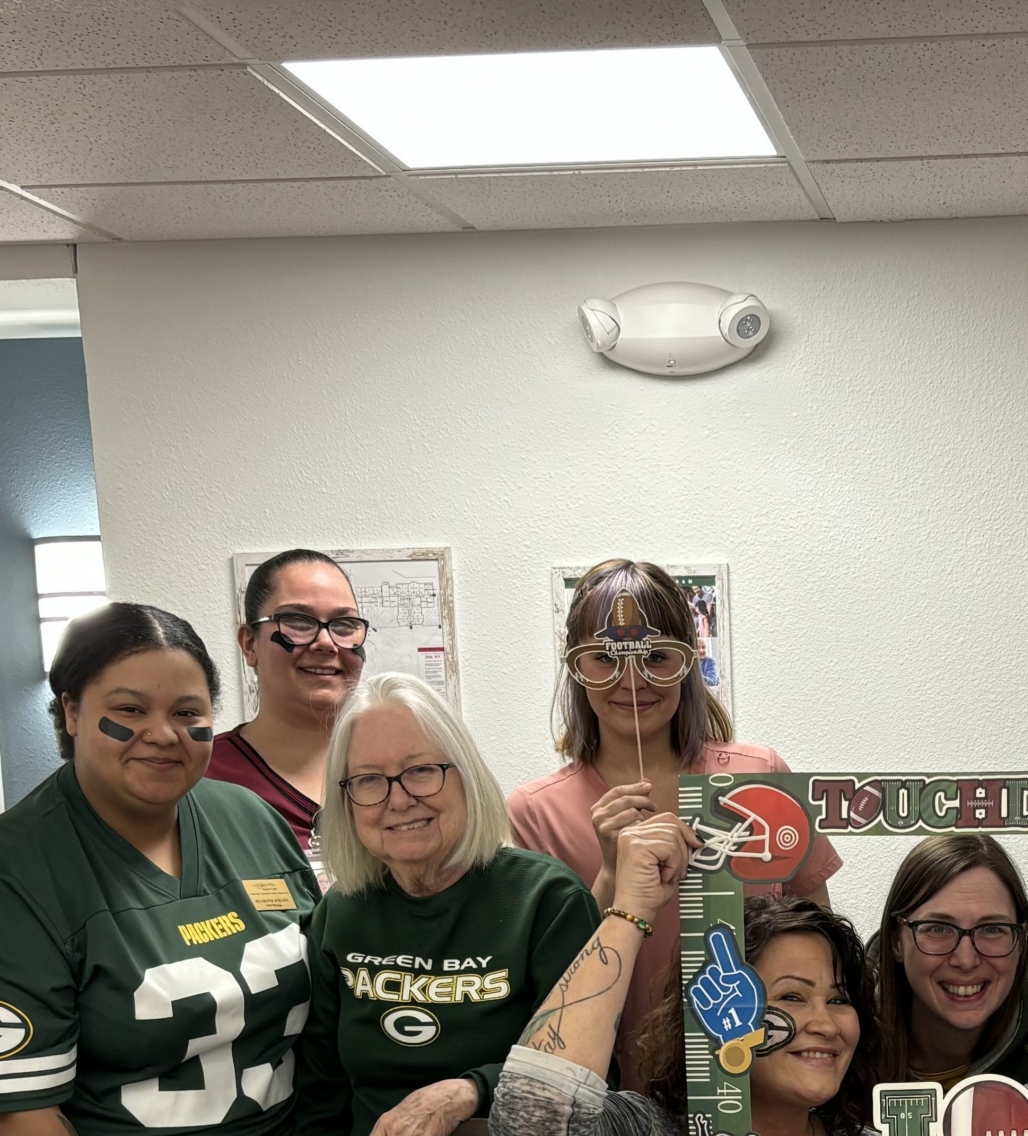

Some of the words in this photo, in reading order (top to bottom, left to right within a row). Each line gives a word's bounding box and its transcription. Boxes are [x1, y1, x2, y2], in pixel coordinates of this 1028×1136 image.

[605, 640, 652, 650] FOOTBALL
[178, 911, 246, 946] PACKERS
[346, 952, 432, 970] GREEN
[443, 956, 493, 971] BAY
[380, 1005, 441, 1047] G
[722, 1007, 742, 1031] #1
[717, 1082, 743, 1114] 40
